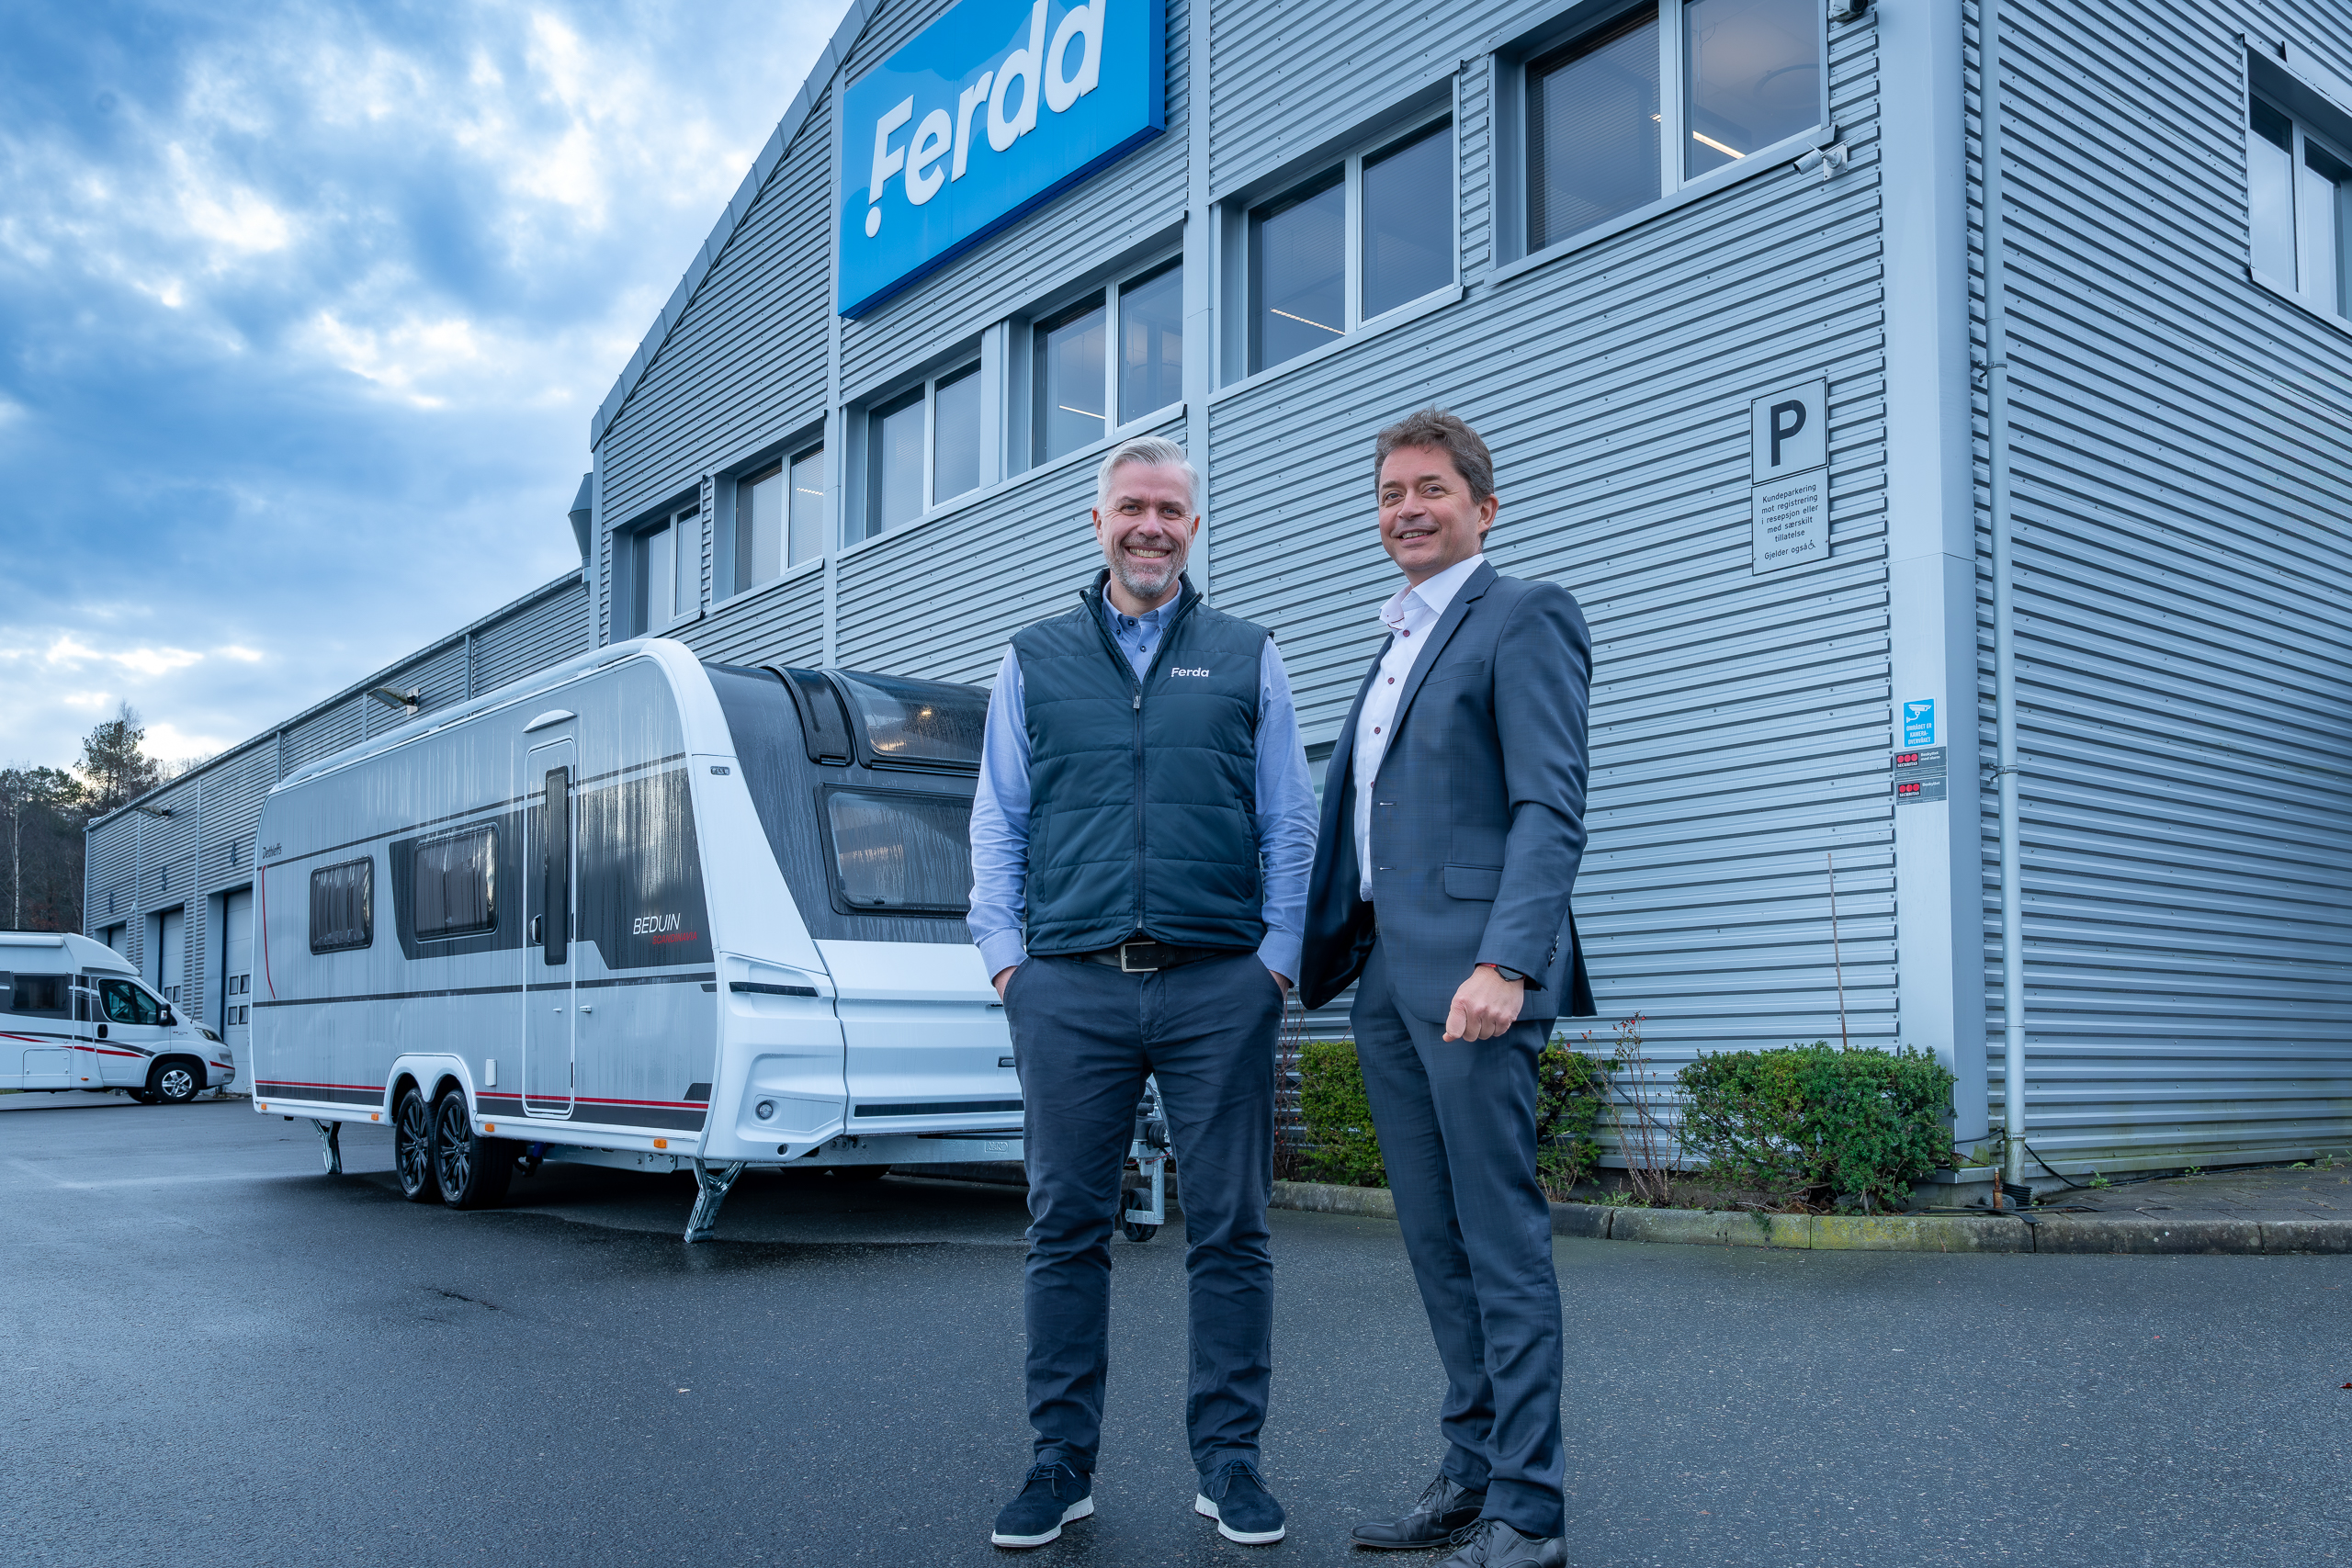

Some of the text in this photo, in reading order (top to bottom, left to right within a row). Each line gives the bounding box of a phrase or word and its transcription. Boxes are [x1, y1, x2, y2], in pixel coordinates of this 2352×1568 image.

[865, 0, 1106, 237] Ferda
[1770, 400, 1806, 467] P
[1762, 484, 1816, 503] Kundeparkering
[1761, 494, 1818, 514] mot registrering
[1766, 510, 1801, 524] resepsjon
[1803, 505, 1819, 514] eller
[1767, 516, 1813, 534] med særskilt
[1774, 529, 1805, 542] tillatelse
[1764, 542, 1808, 560] Gjelder også
[1170, 667, 1210, 678] Ferda
[632, 912, 681, 935] BEDUIN
[651, 931, 697, 945] SCANDINAVIA
